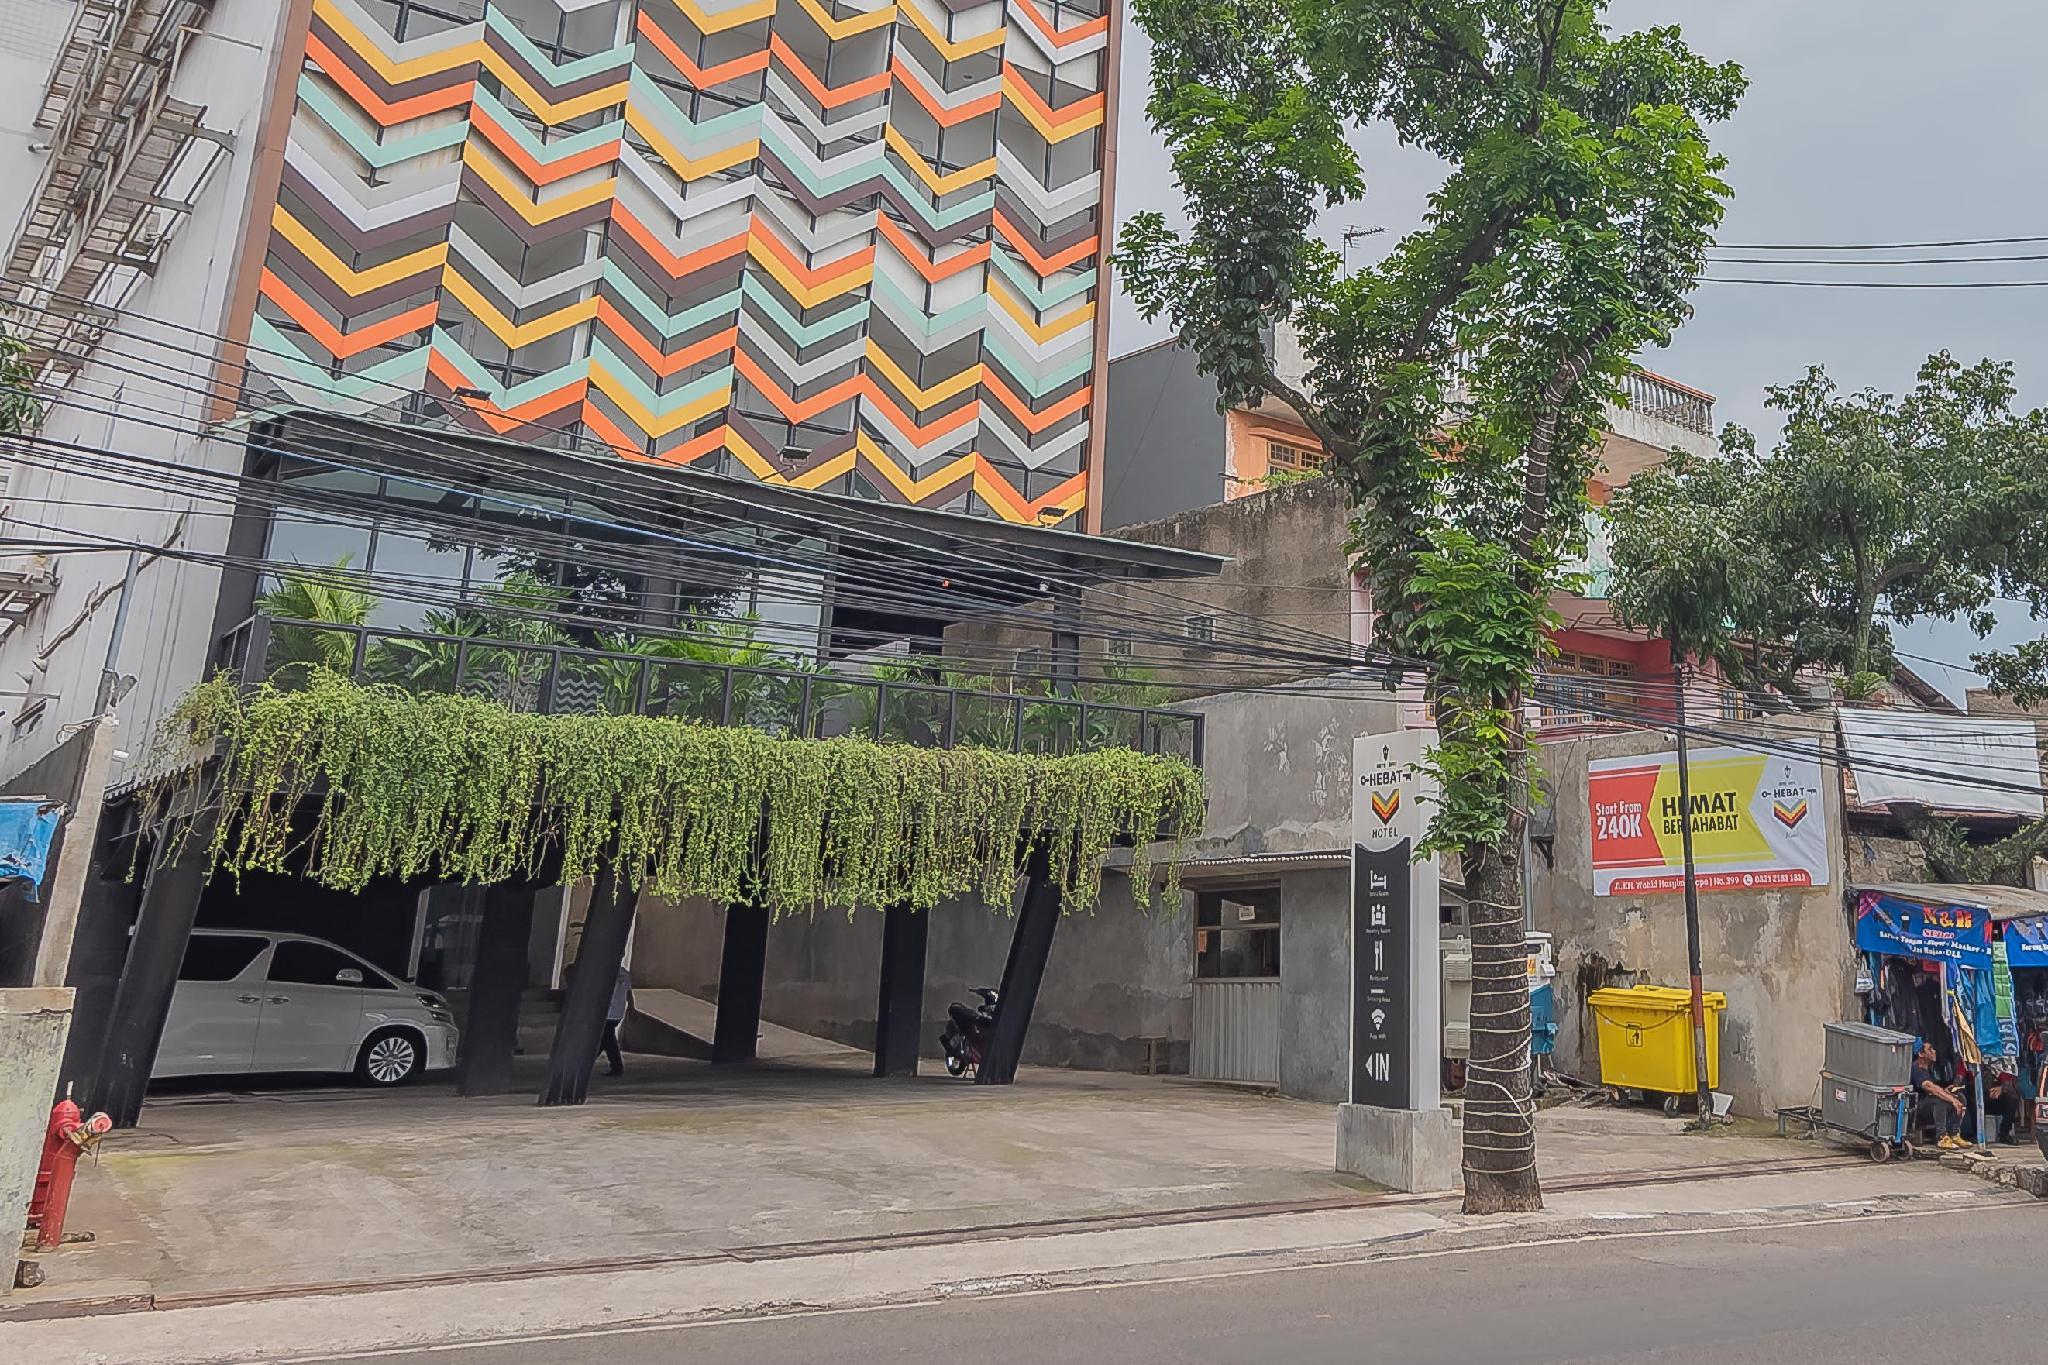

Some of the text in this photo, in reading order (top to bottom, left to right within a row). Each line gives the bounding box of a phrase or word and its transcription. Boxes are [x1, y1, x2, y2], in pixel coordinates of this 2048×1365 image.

[1370, 769, 1403, 787] HEBAT
[1774, 787, 1804, 798] HEBAT
[1595, 800, 1642, 816] Start From
[1372, 826, 1398, 839] HOTEL
[1597, 812, 1642, 840] 240K
[1663, 814, 1739, 835] BERAHABAT
[1375, 1053, 1390, 1082] IN
